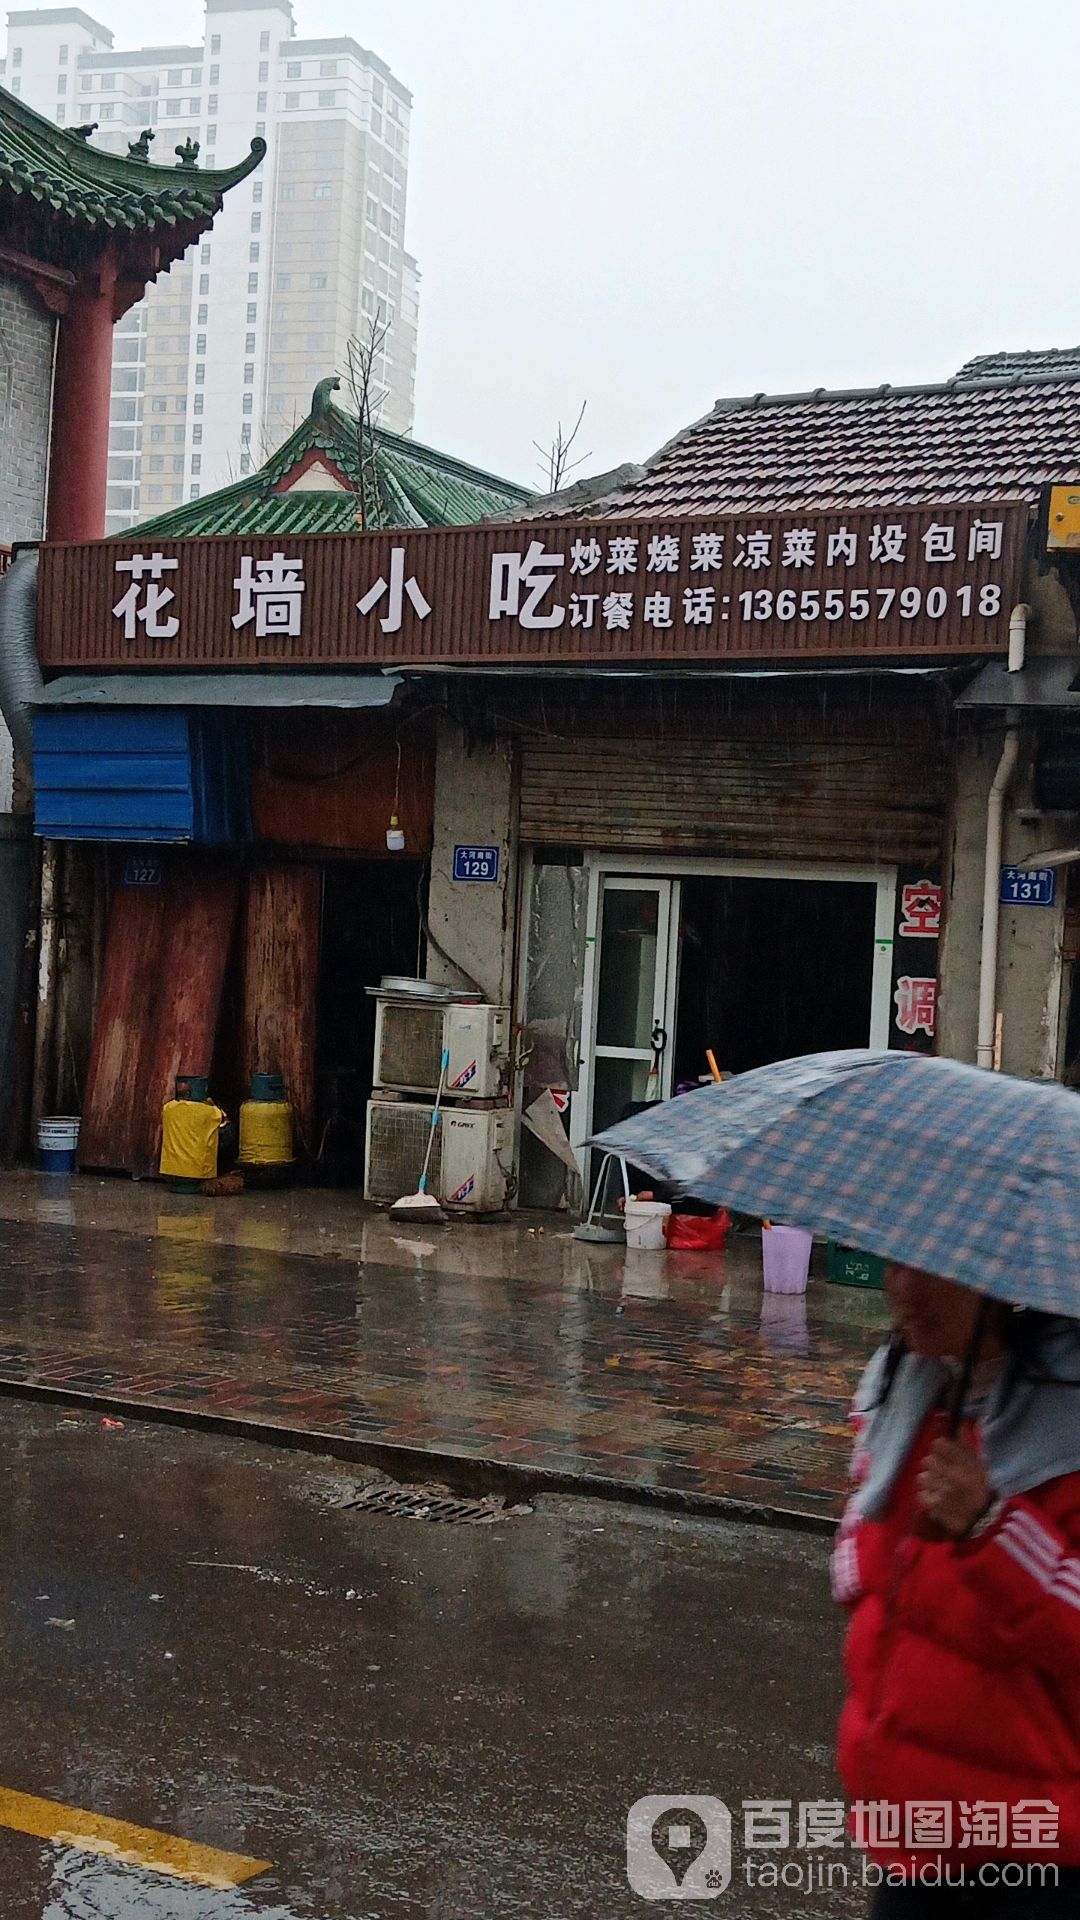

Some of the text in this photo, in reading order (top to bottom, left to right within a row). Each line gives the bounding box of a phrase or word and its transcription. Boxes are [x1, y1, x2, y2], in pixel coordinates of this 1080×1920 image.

[569, 519, 1003, 575] 炒菜烧菜凉菜内设包间
[112, 540, 567, 640] 花墙小吃
[568, 584, 1001, 632] 订餐电话:13655579018
[133, 868, 156, 881] 127
[463, 861, 489, 876] 129
[1010, 882, 1041, 899] 131
